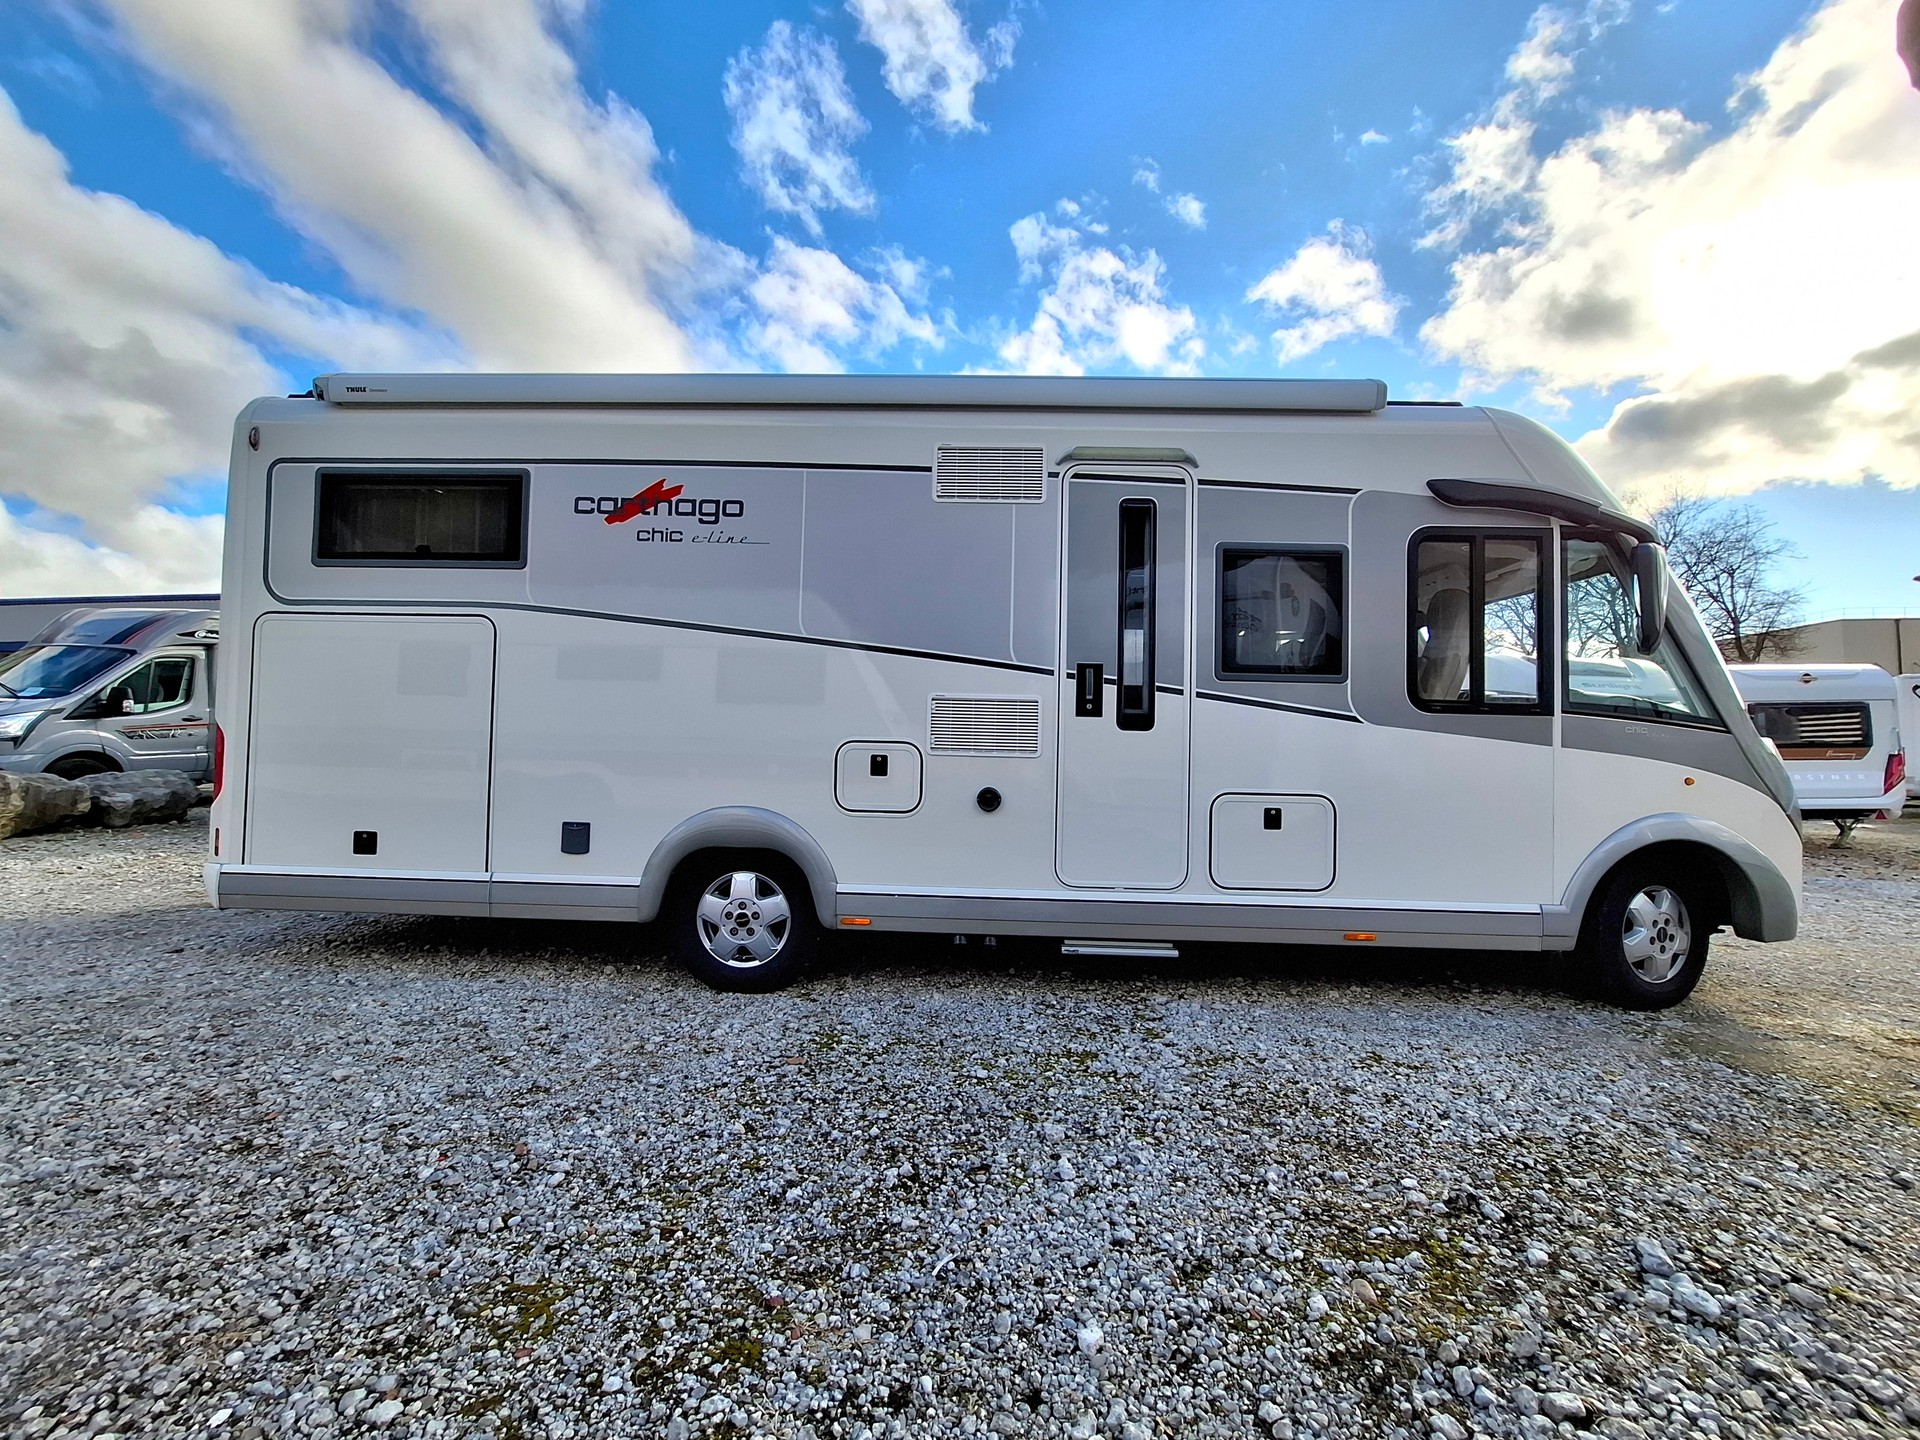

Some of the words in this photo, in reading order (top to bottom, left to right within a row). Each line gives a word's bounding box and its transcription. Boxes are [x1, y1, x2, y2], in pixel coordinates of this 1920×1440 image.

[573, 494, 745, 525] carthago
[636, 527, 684, 543] chic
[691, 530, 770, 545] e-line
[1624, 725, 1648, 734] chic
